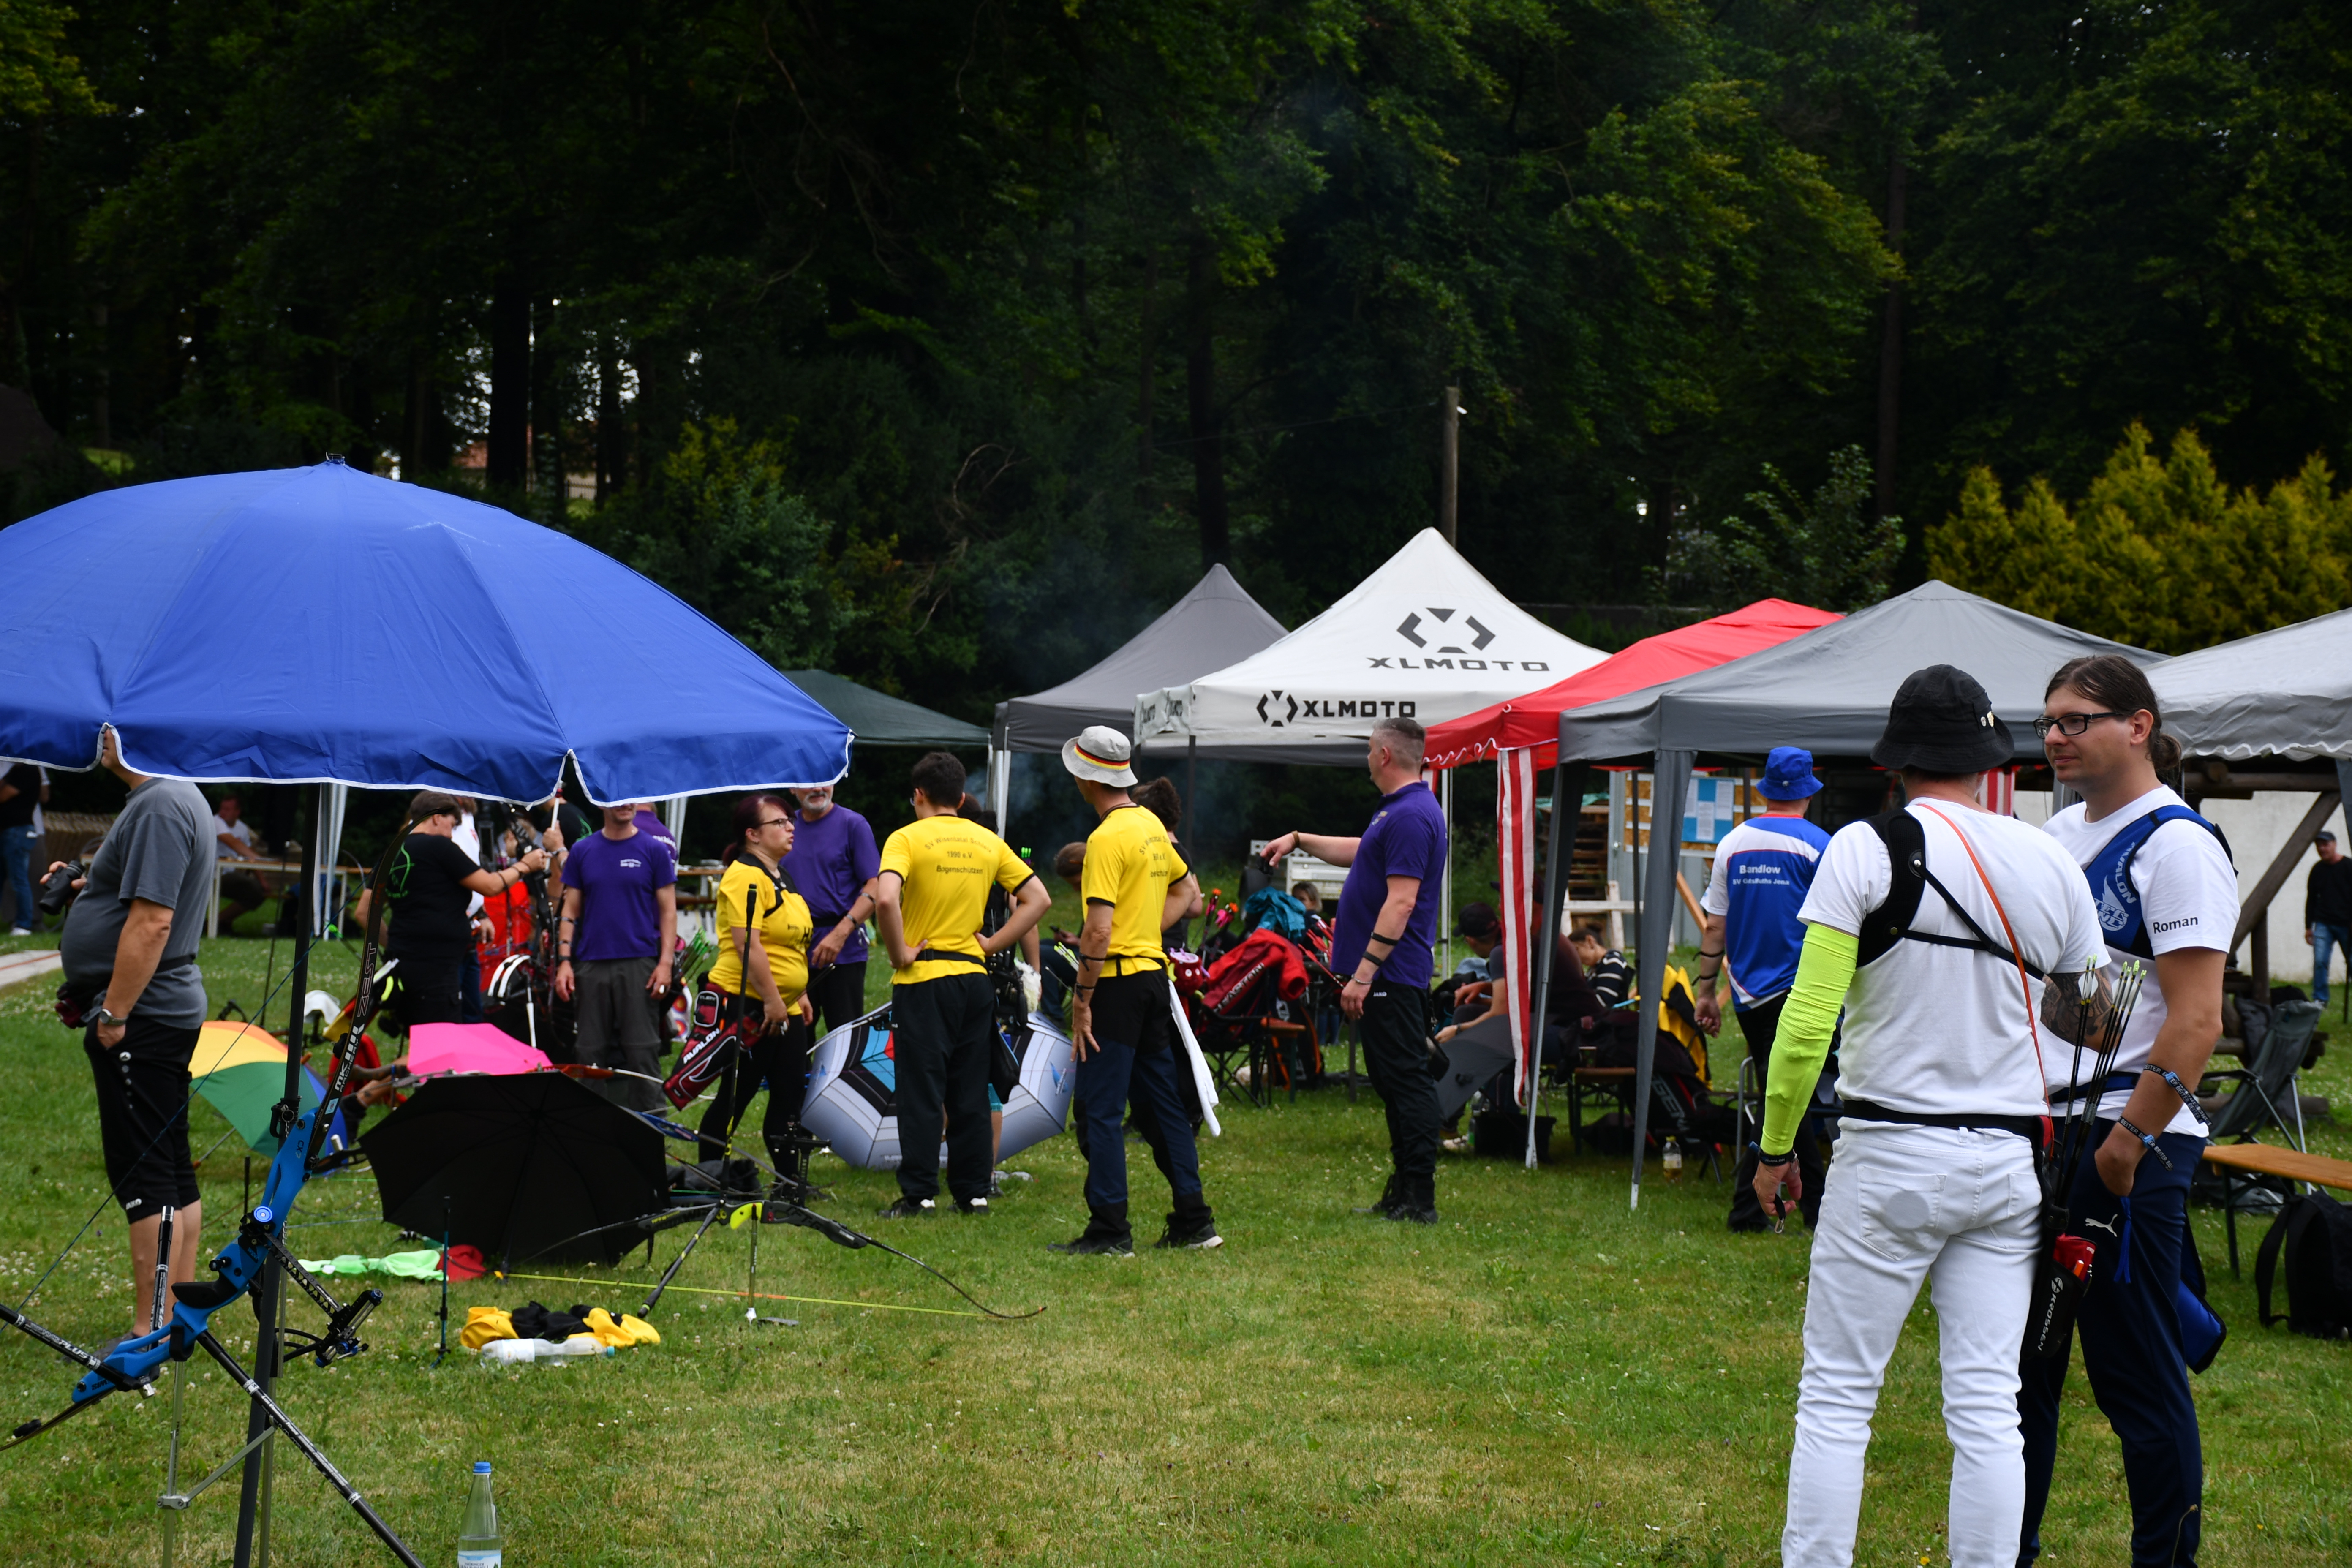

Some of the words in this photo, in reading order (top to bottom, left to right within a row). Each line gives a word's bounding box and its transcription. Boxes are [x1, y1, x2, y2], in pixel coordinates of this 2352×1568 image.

[1366, 657, 1550, 671] XLMOTO
[1302, 700, 1416, 718] XLMOTO
[1739, 864, 1781, 874] Bandlow
[2153, 917, 2199, 934] Roman
[357, 942, 376, 1017] ZEST
[683, 1028, 720, 1064] AVALON
[339, 1038, 359, 1092] ARCHERY
[2120, 1118, 2139, 1135] BEITER
[2154, 1146, 2168, 1163] BEITER
[2037, 1293, 2057, 1351] KROSSEN
[58, 1339, 89, 1359] PLUS
